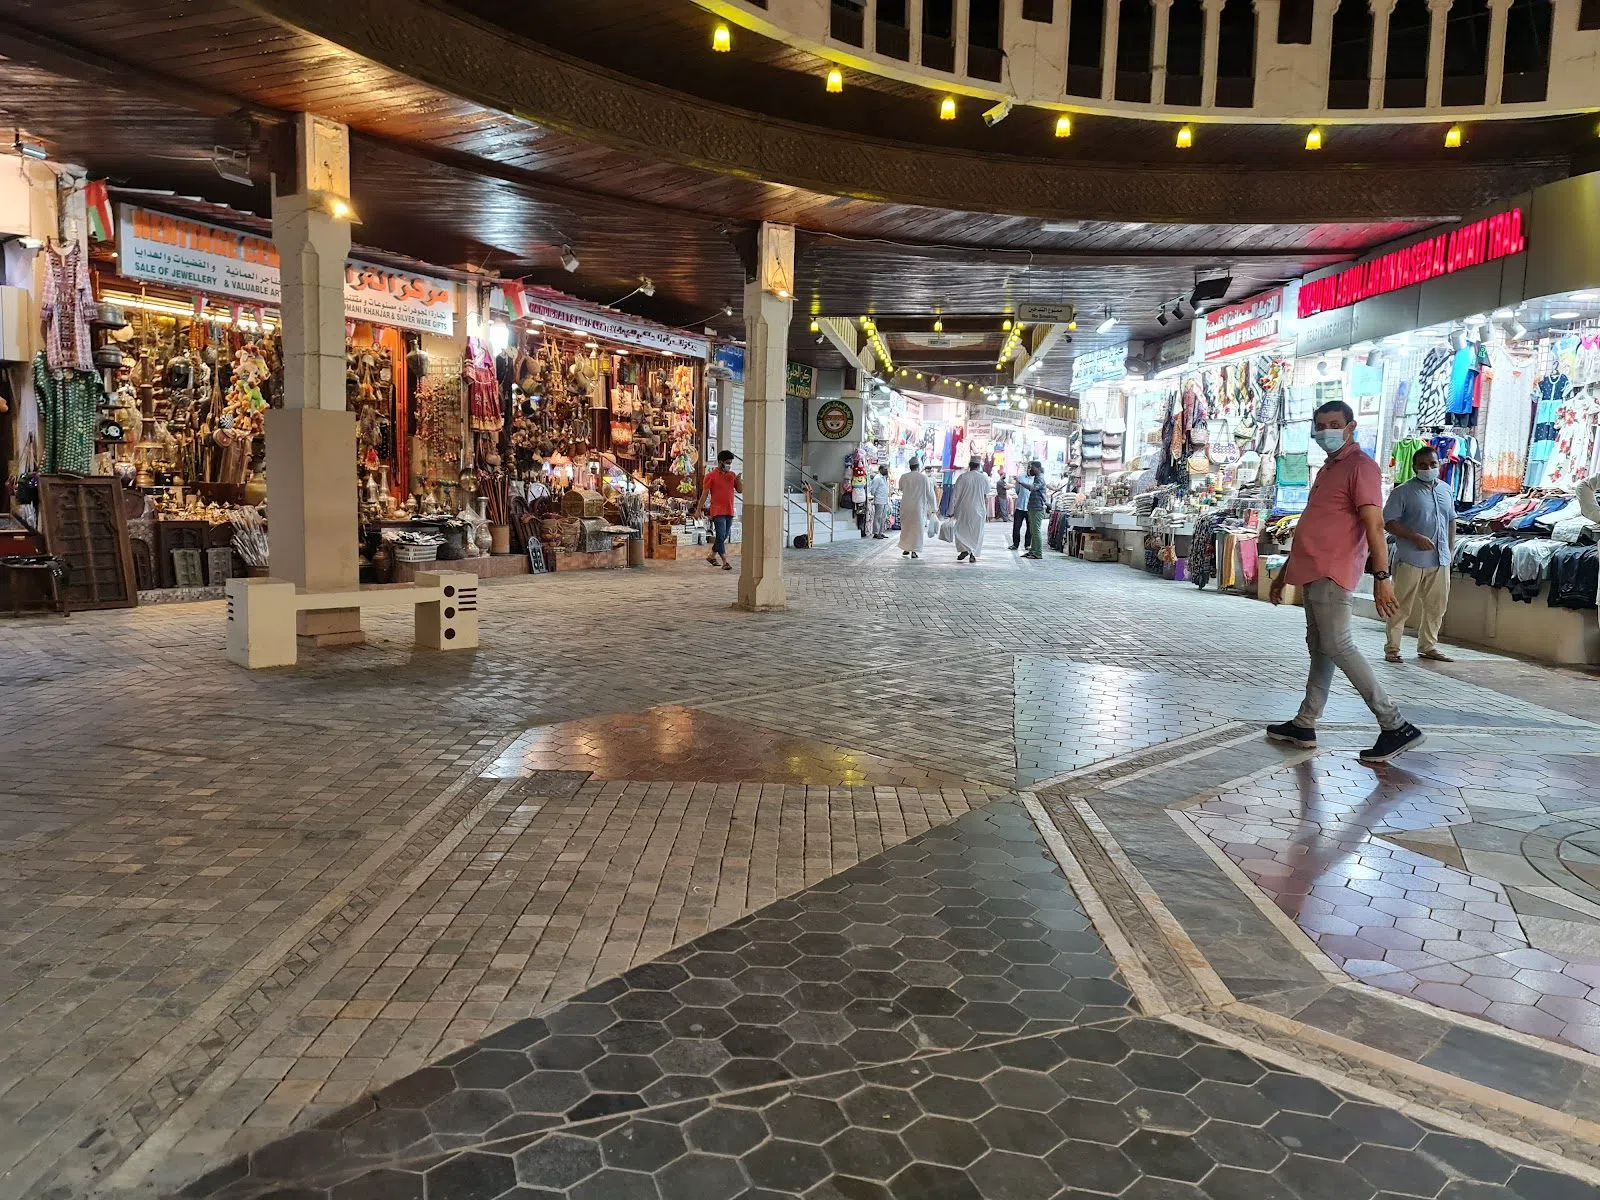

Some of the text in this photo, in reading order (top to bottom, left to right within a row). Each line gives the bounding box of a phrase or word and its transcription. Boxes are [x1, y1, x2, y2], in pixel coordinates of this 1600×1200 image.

[135, 262, 156, 274] SALE
[158, 265, 169, 277] OF
[171, 270, 217, 286] JEWELLERY
[232, 281, 269, 295] VALUABLE
[270, 286, 281, 297] AR
[346, 264, 449, 306] مركز الترا
[364, 306, 391, 319] KHANJAR
[396, 313, 416, 324] SILVER
[416, 317, 431, 327] WARE
[432, 320, 448, 330] GIFTS
[1242, 320, 1276, 344] FASHION
